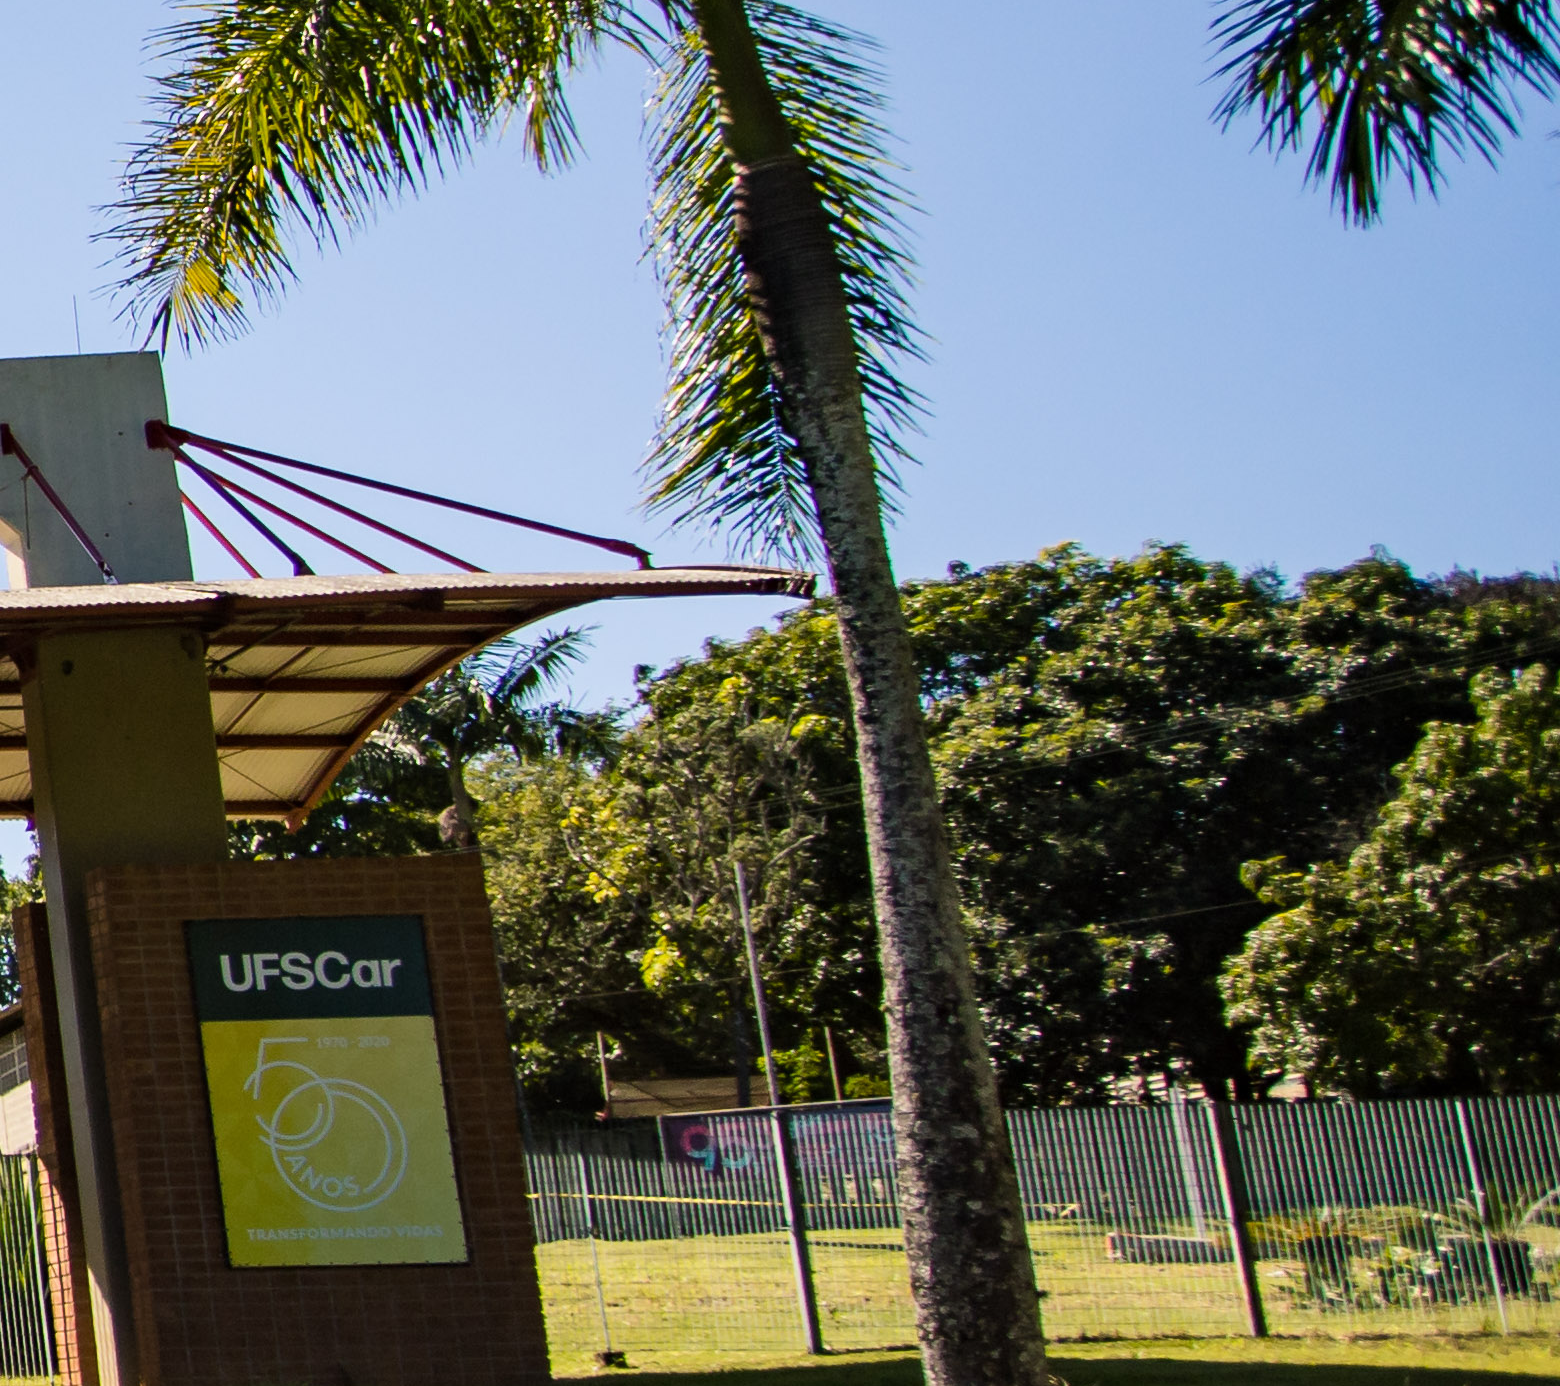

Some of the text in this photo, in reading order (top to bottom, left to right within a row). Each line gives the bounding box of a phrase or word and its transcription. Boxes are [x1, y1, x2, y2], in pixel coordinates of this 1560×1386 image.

[220, 950, 402, 992] UFSCar
[285, 1153, 361, 1199] ANOS
[247, 1224, 444, 1241] TRANSFORMANDO VIDAS
